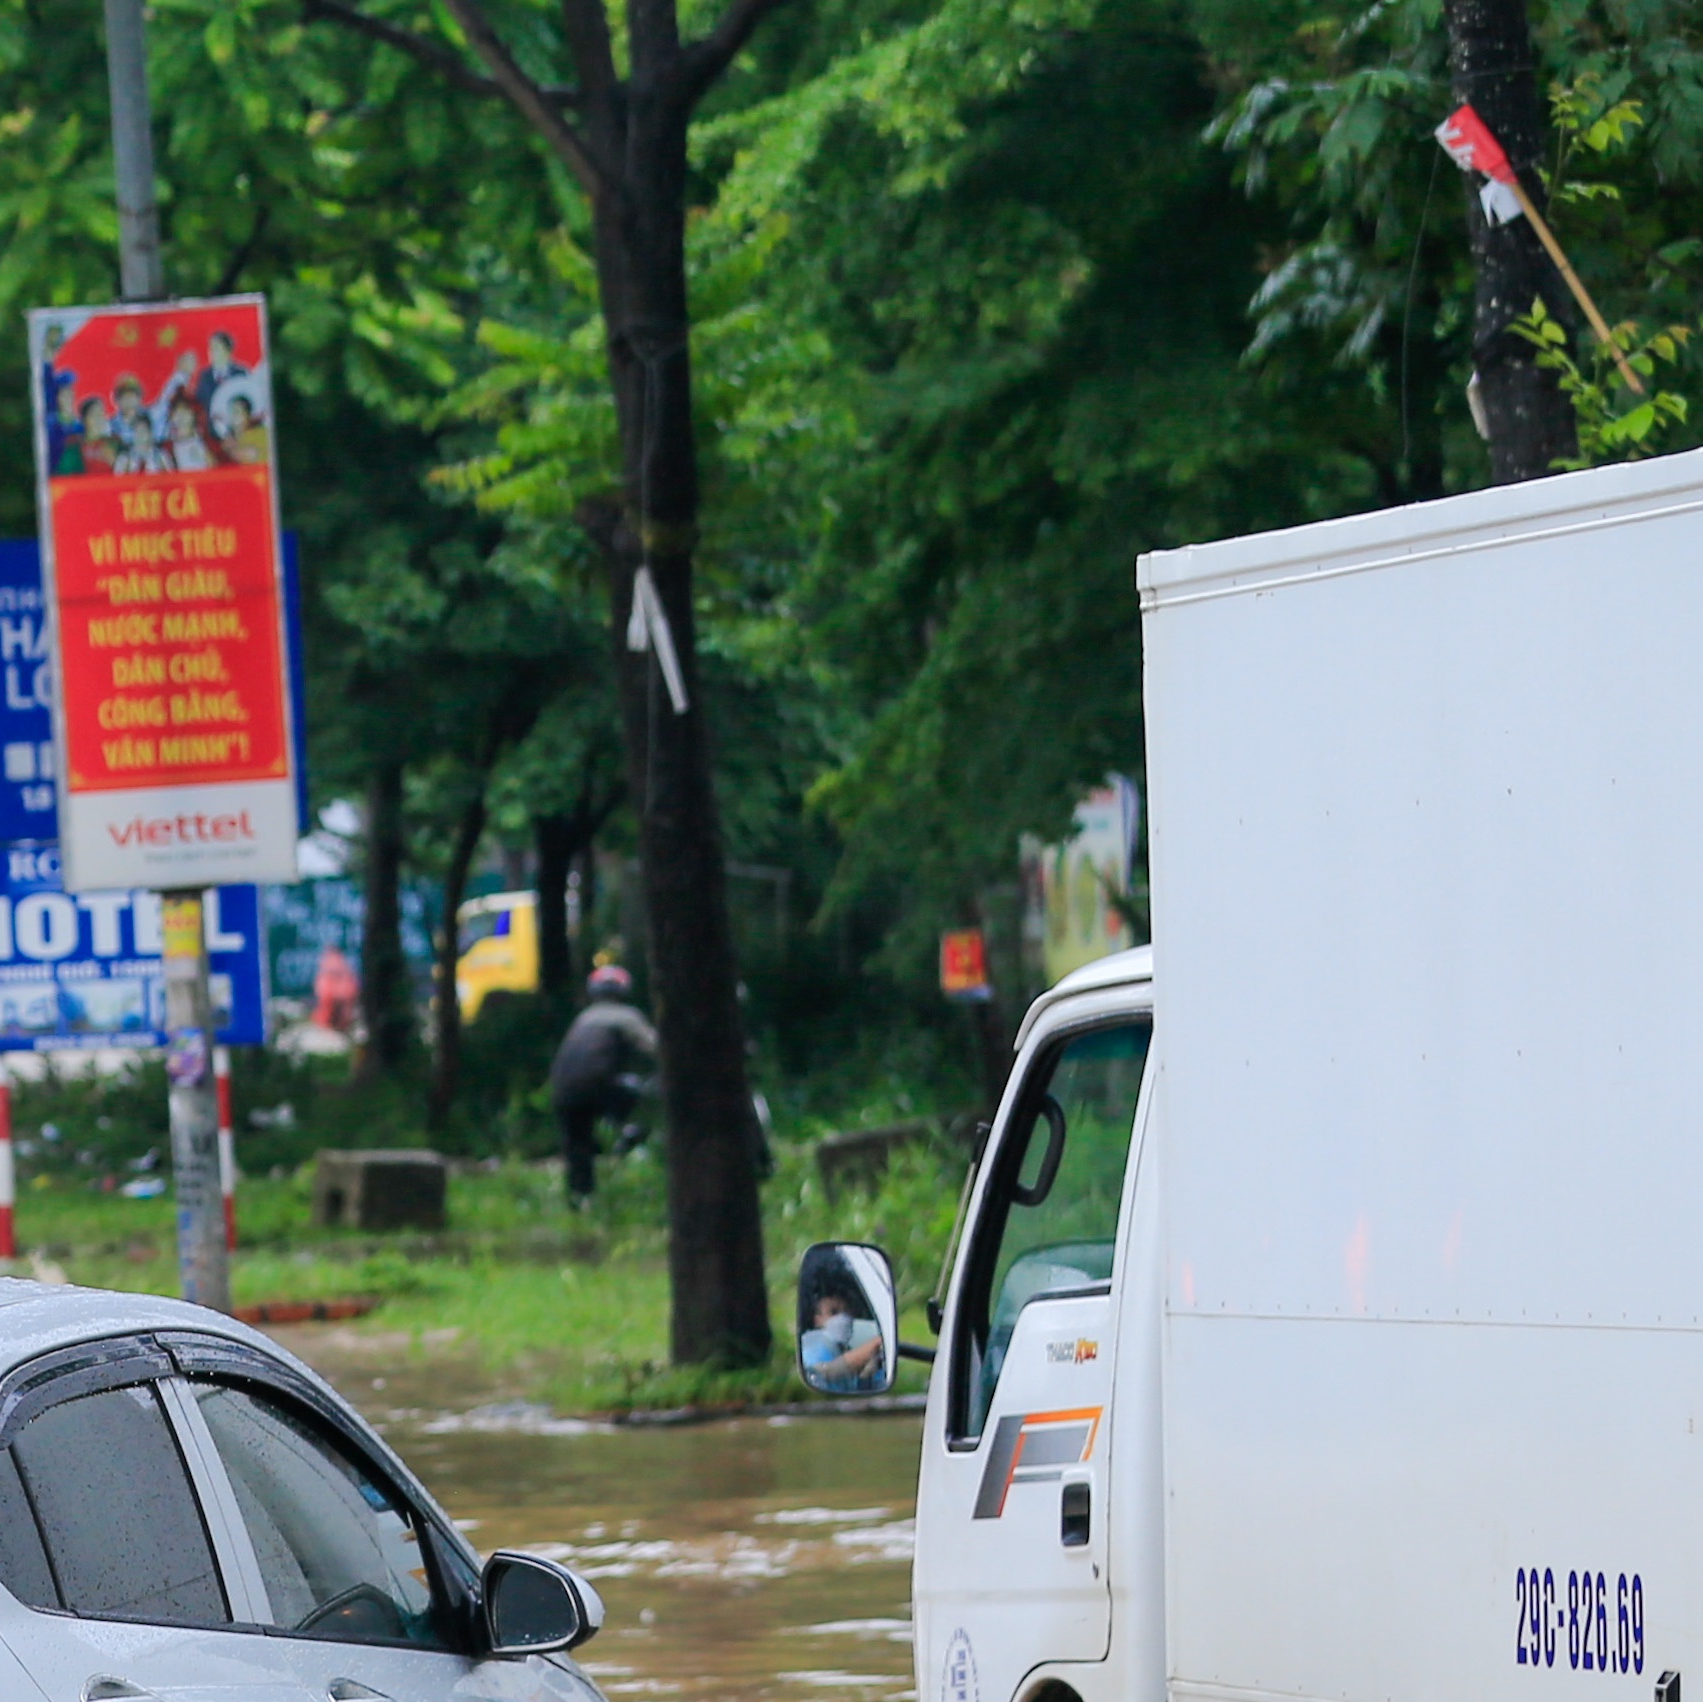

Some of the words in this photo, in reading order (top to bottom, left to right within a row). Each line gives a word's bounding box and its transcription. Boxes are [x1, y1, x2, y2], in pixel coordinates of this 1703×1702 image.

[120, 531, 175, 567] MỤC
[181, 525, 236, 559] TIÊU
[112, 652, 165, 688] DÂN
[98, 694, 166, 729] CÔNG
[107, 808, 256, 849] viettel
[1517, 1567, 1644, 1675] 29C-826.69
